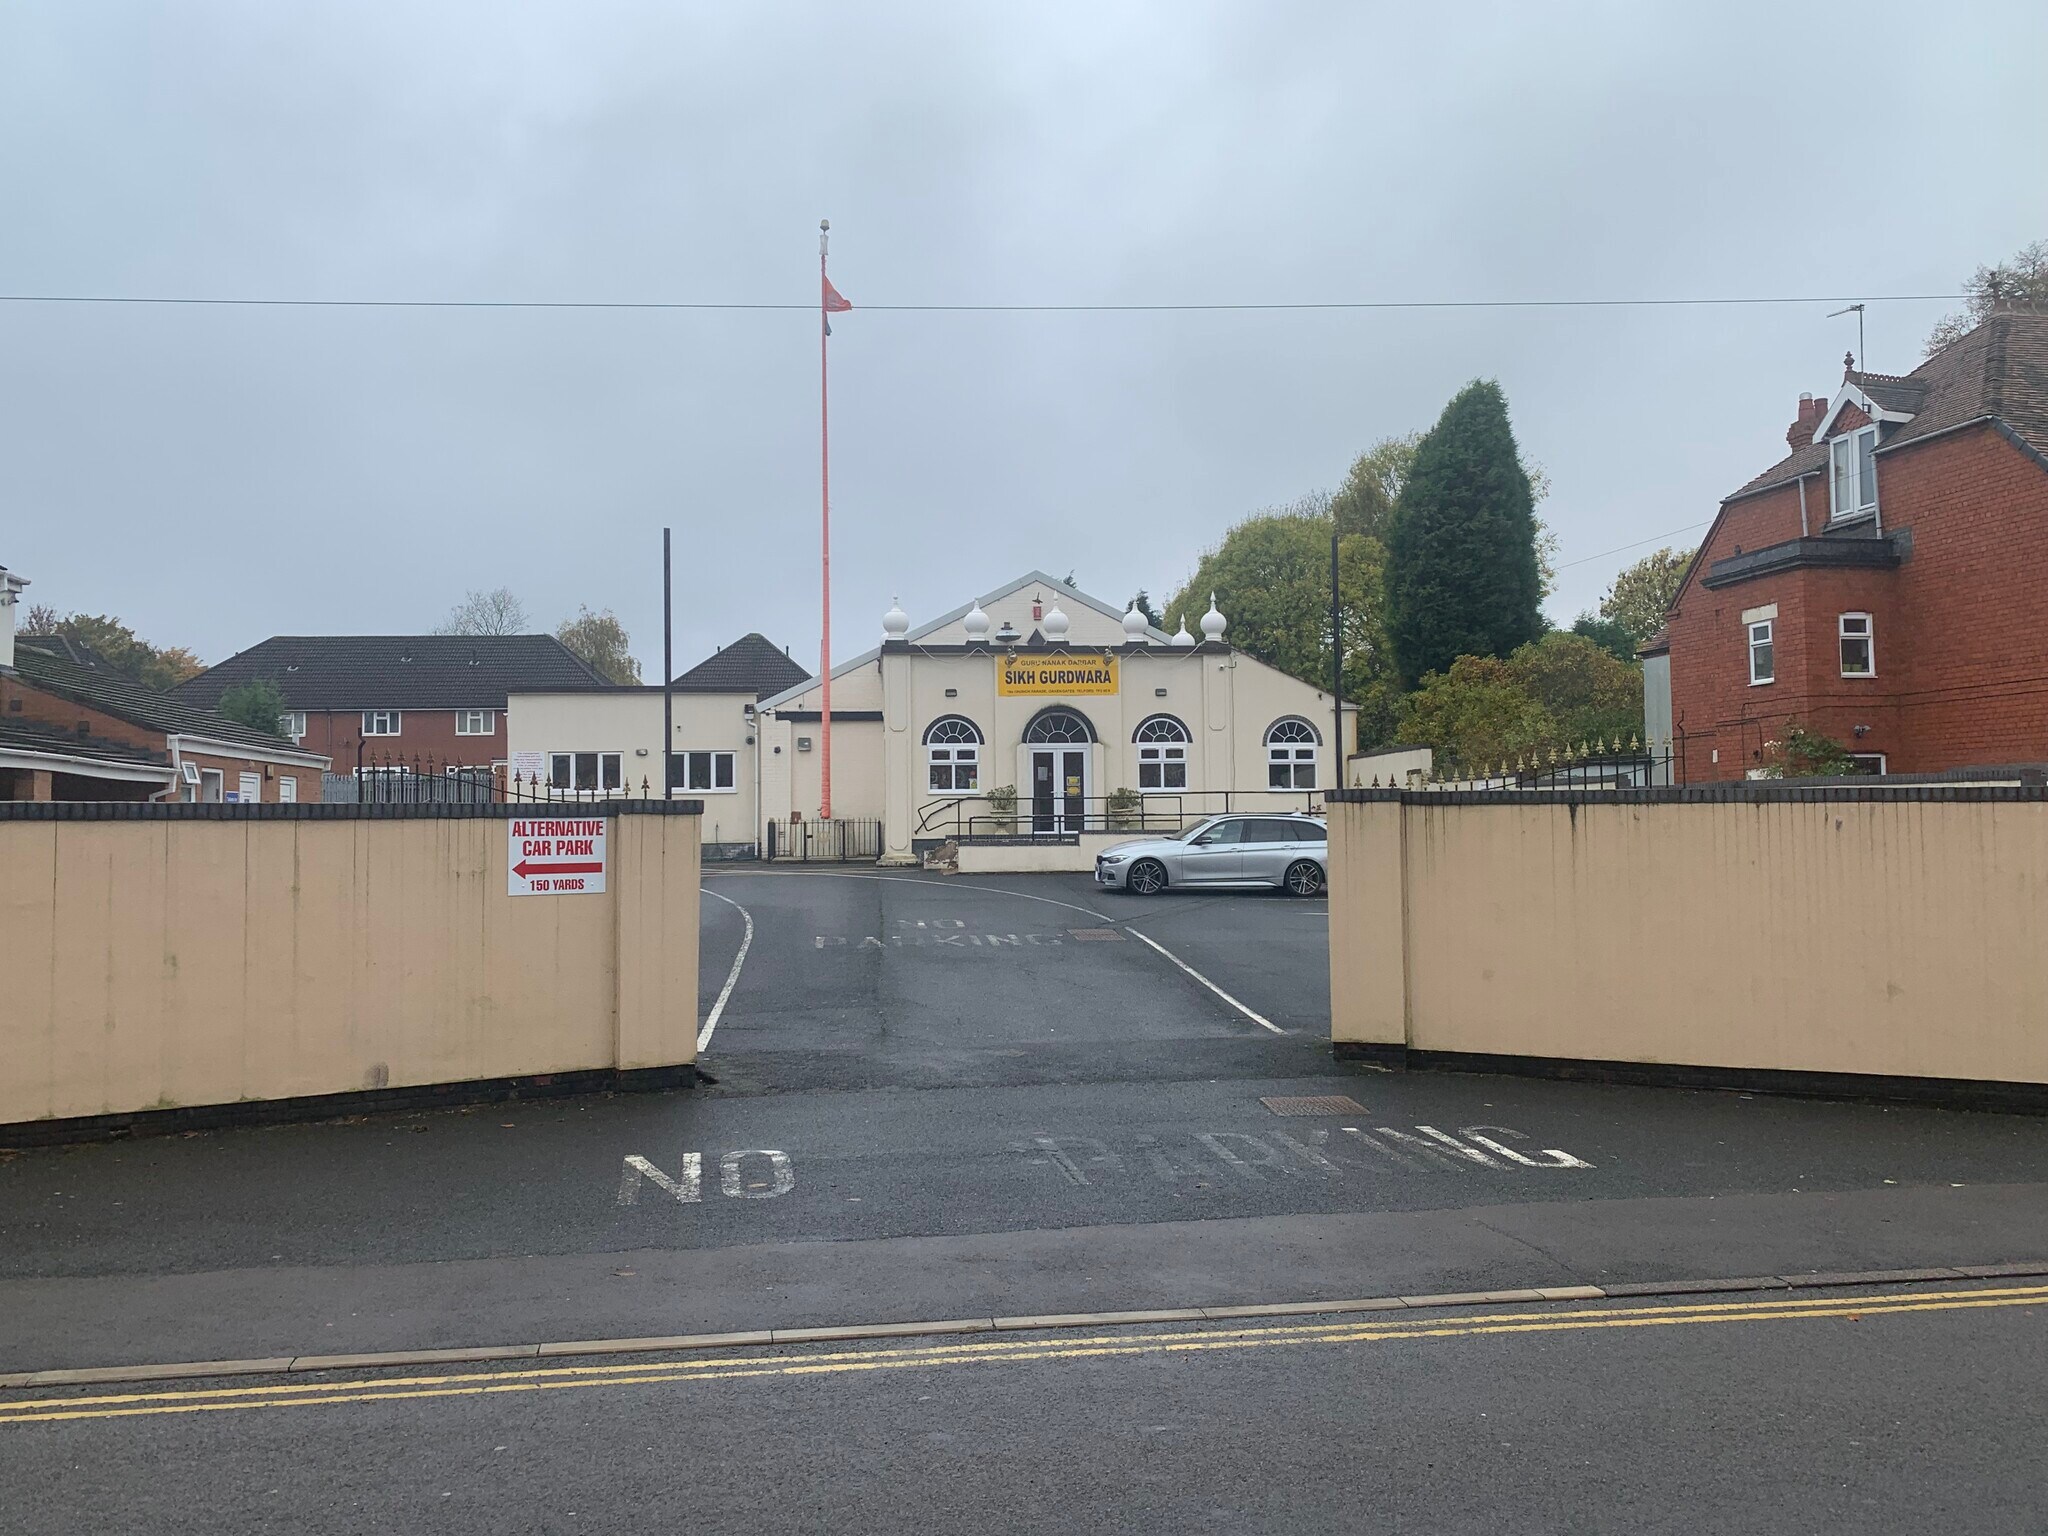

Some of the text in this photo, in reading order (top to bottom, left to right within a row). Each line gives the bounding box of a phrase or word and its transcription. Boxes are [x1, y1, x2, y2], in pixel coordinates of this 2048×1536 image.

[1005, 669, 1112, 684] SIKH GURDWARA
[512, 820, 604, 837] ALTERNATIVE
[522, 839, 594, 857] CAR PARK
[530, 878, 585, 891] 150 YARDS
[1028, 1124, 1598, 1185] PRKING
[614, 1149, 796, 1206] NO
